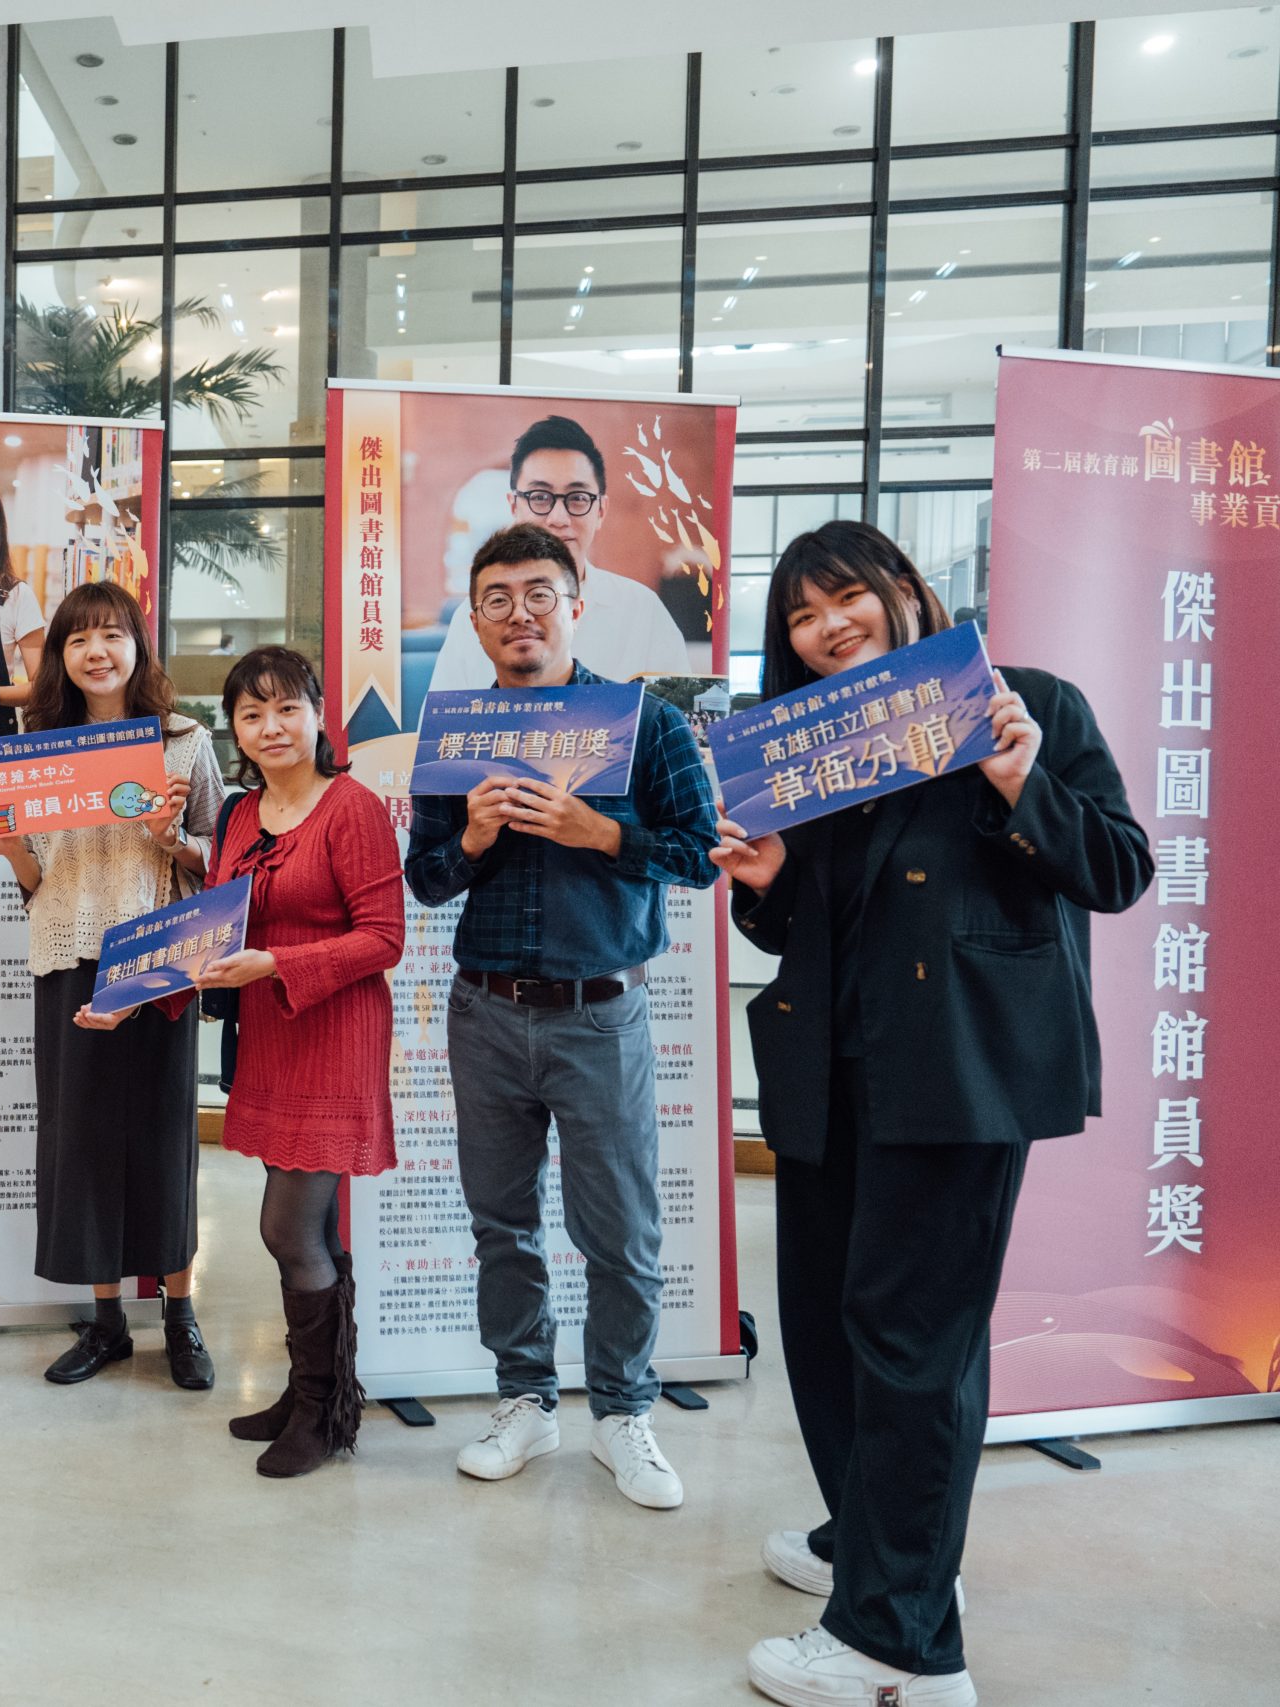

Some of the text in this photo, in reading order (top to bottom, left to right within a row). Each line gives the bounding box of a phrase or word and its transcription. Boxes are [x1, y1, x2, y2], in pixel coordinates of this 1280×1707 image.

[1022, 417, 1271, 487] 第二屆教育部 圖書館
[360, 436, 384, 652] 傑出圖書館館員獎
[469, 698, 511, 715] 圖書館
[513, 701, 567, 713] 事業貢獻獎
[760, 677, 947, 767] 高雄市立圖書館
[771, 695, 826, 726] 圖書館
[827, 670, 897, 704] 事業貢獻獎
[76, 727, 156, 747] 傑出圖書館館員獎
[437, 728, 610, 760] 標竿圖書館獎
[764, 713, 957, 812] 草衙分館
[24, 791, 106, 818] 館員 小玉
[1143, 570, 1216, 1257] 傑出圖書館館員獎
[106, 922, 233, 985] 傑出圖書館館員獎
